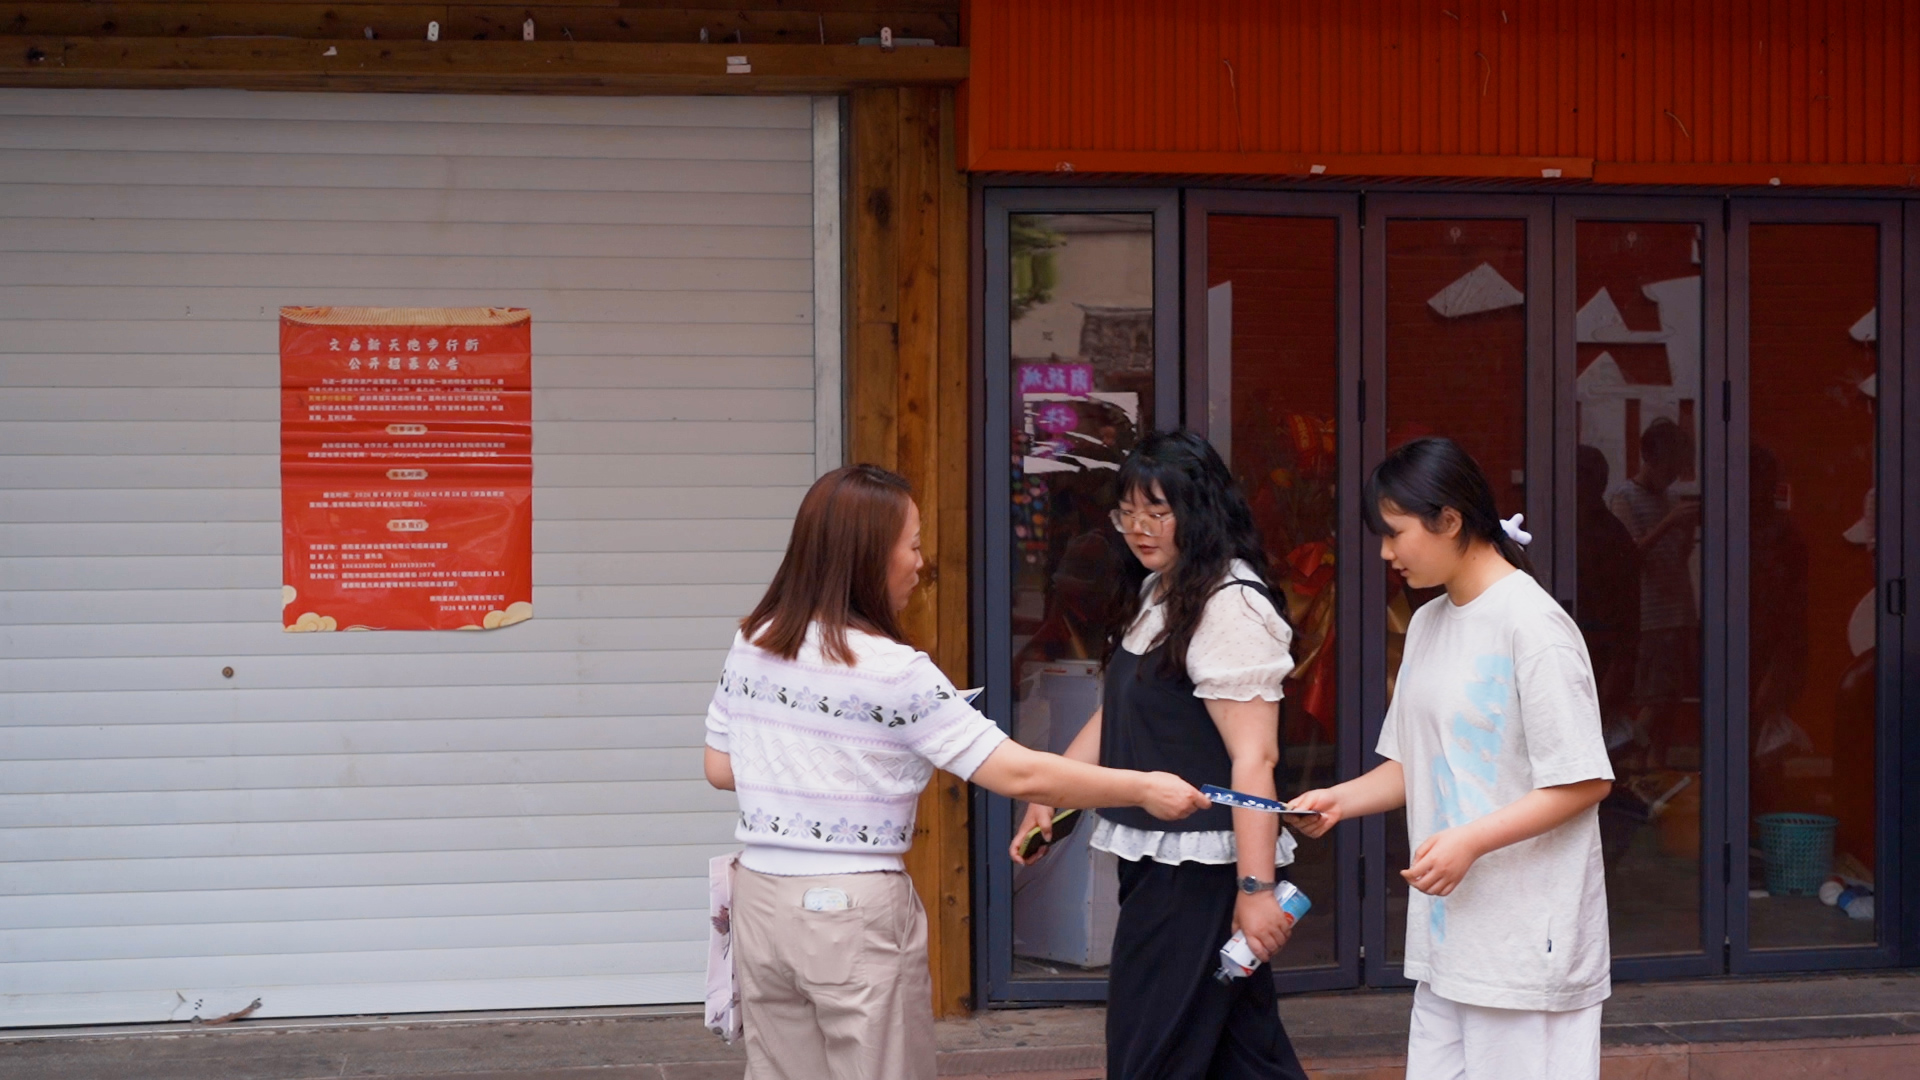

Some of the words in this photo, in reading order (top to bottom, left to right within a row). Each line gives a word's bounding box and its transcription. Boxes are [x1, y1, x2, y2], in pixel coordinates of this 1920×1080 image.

[329, 338, 479, 351] 文庙新天地步行街
